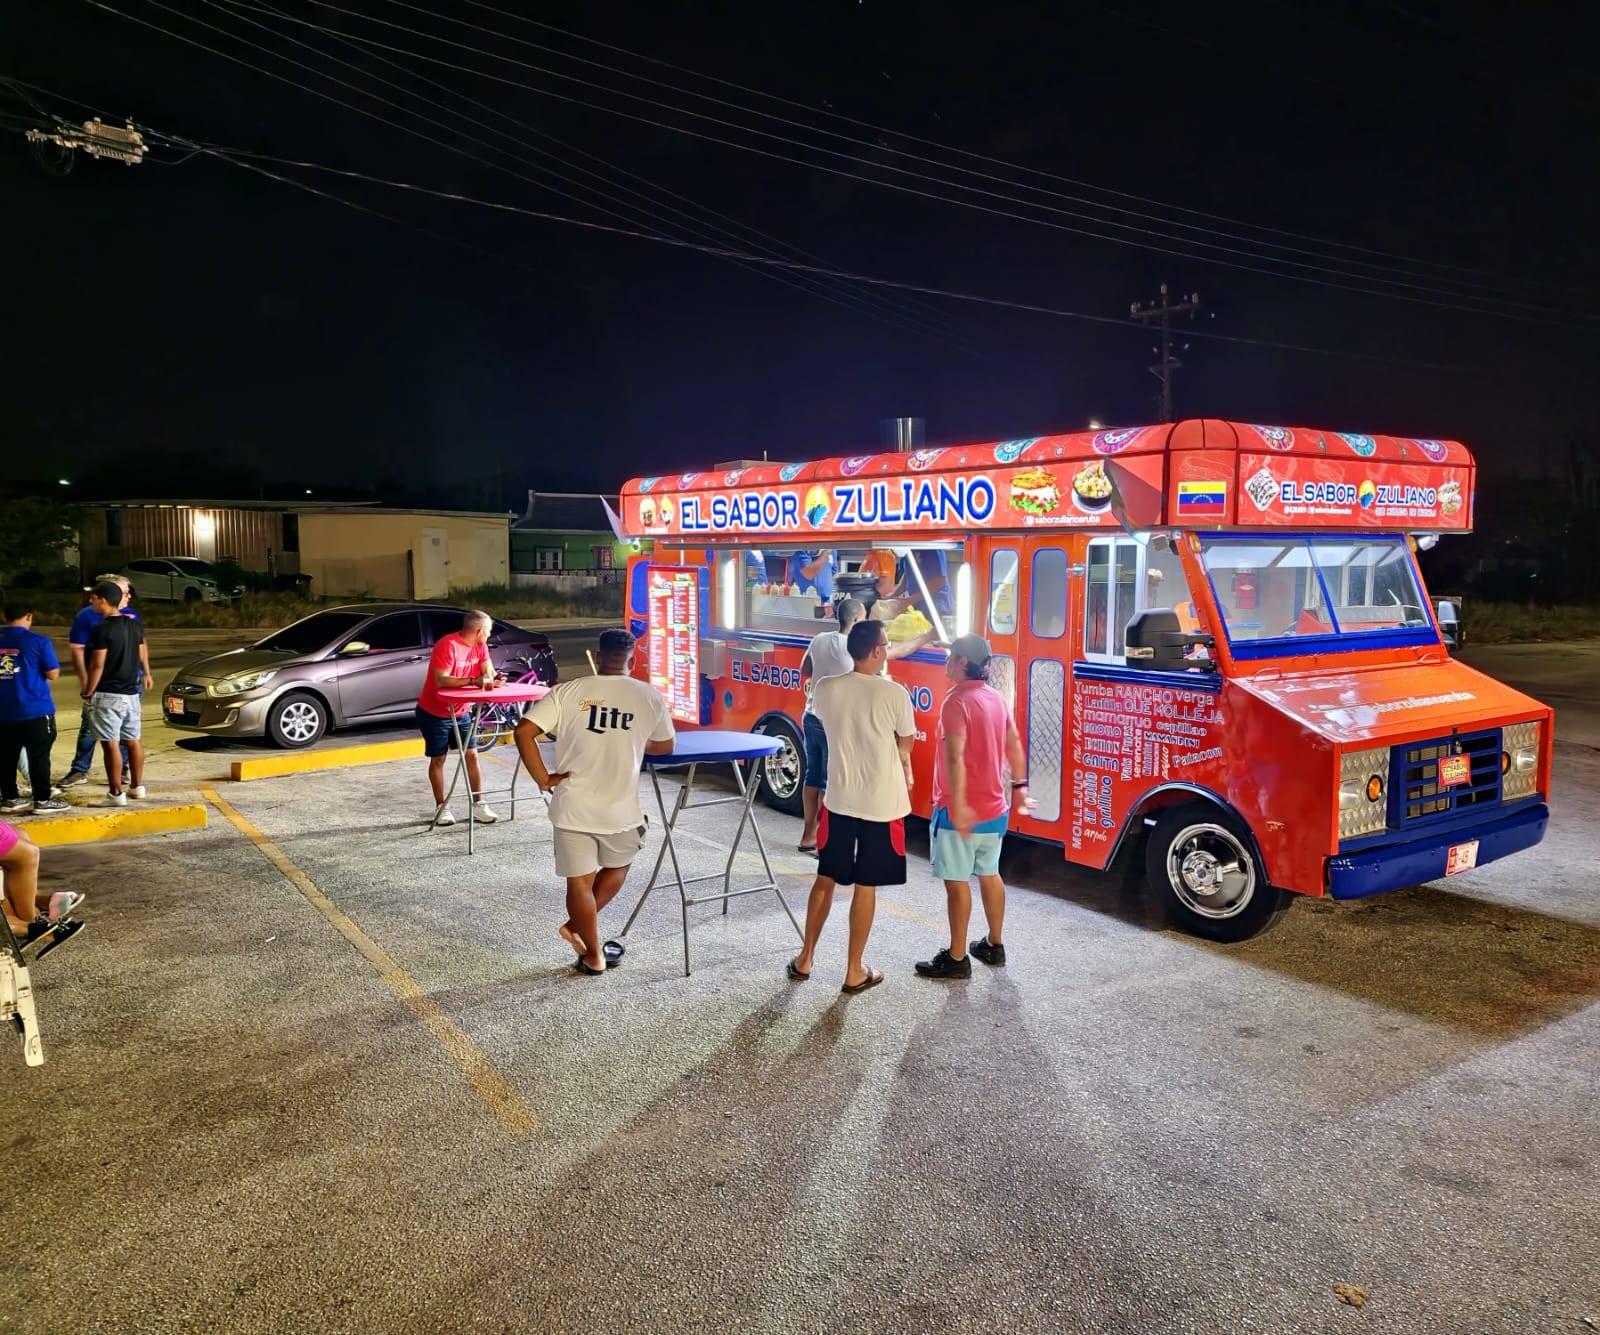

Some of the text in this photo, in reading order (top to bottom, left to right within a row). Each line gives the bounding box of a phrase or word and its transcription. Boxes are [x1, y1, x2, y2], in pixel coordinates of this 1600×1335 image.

[681, 477, 995, 530] EL SABOR ZULIANO
[1281, 483, 1302, 501] EL
[1304, 483, 1356, 504] SABOR
[1377, 486, 1436, 506] ZULIANO
[732, 660, 801, 691] EL SABOR
[1075, 681, 1214, 708] Tumba RANCHO Verga
[585, 703, 635, 735] Lite
[1124, 698, 1152, 715] QUE
[1154, 702, 1225, 725] MOLLEJA
[1083, 752, 1120, 773] GAITA
